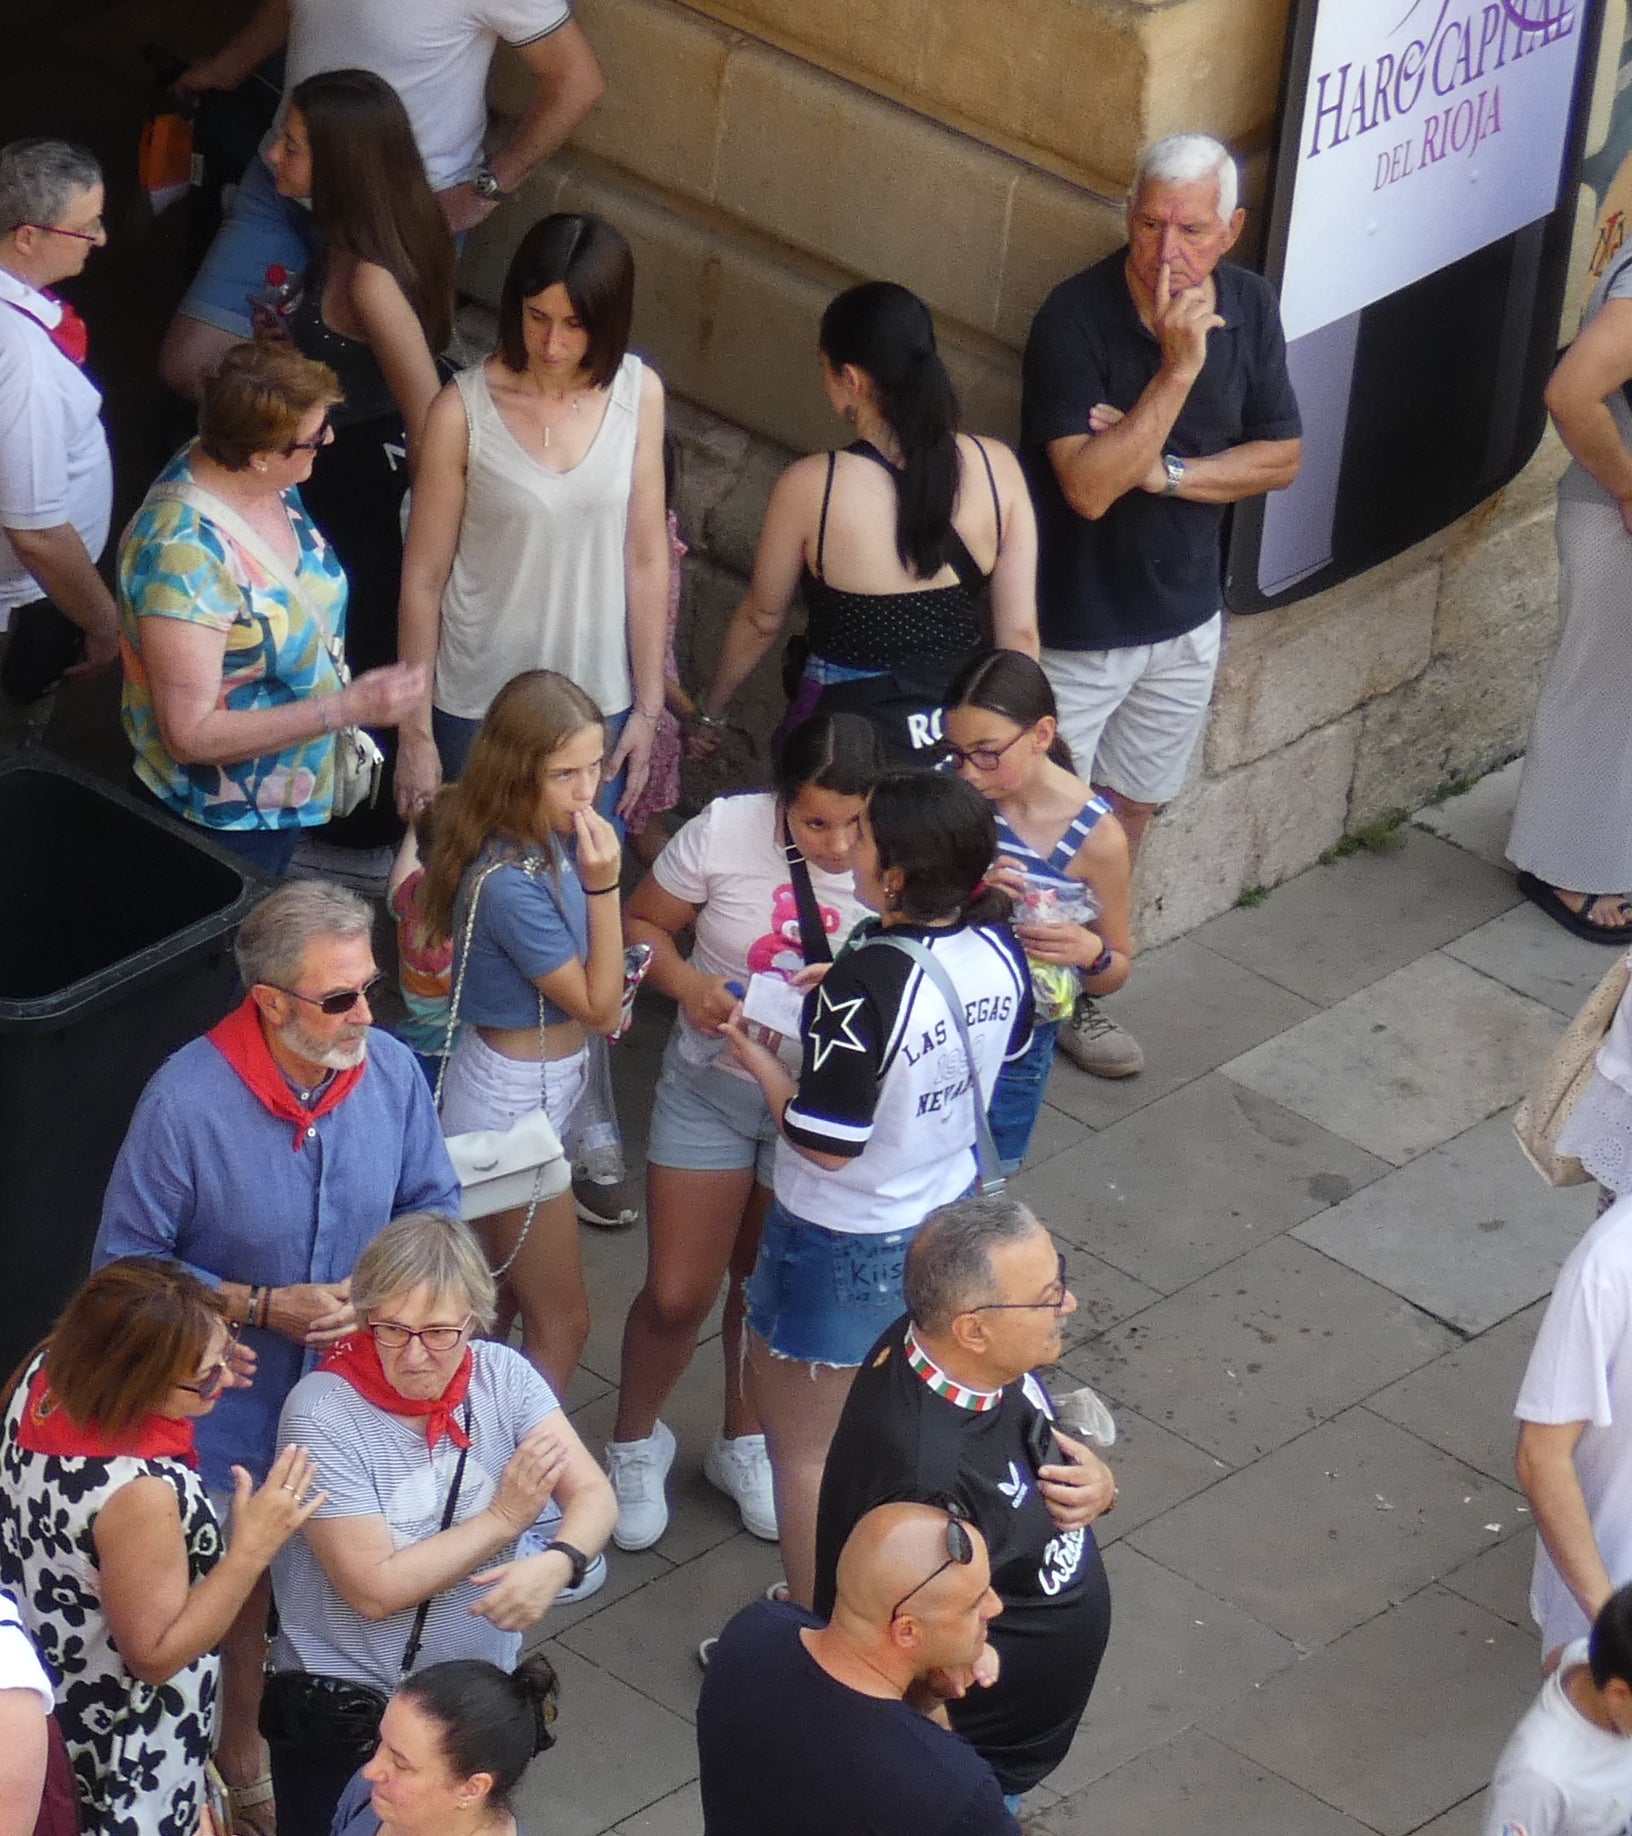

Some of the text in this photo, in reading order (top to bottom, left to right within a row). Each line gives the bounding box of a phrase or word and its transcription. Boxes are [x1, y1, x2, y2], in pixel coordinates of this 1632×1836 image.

[1373, 85, 1502, 192] DEL RIOJA
[901, 1019, 948, 1067] LAS
[965, 995, 1012, 1028] EGAS
